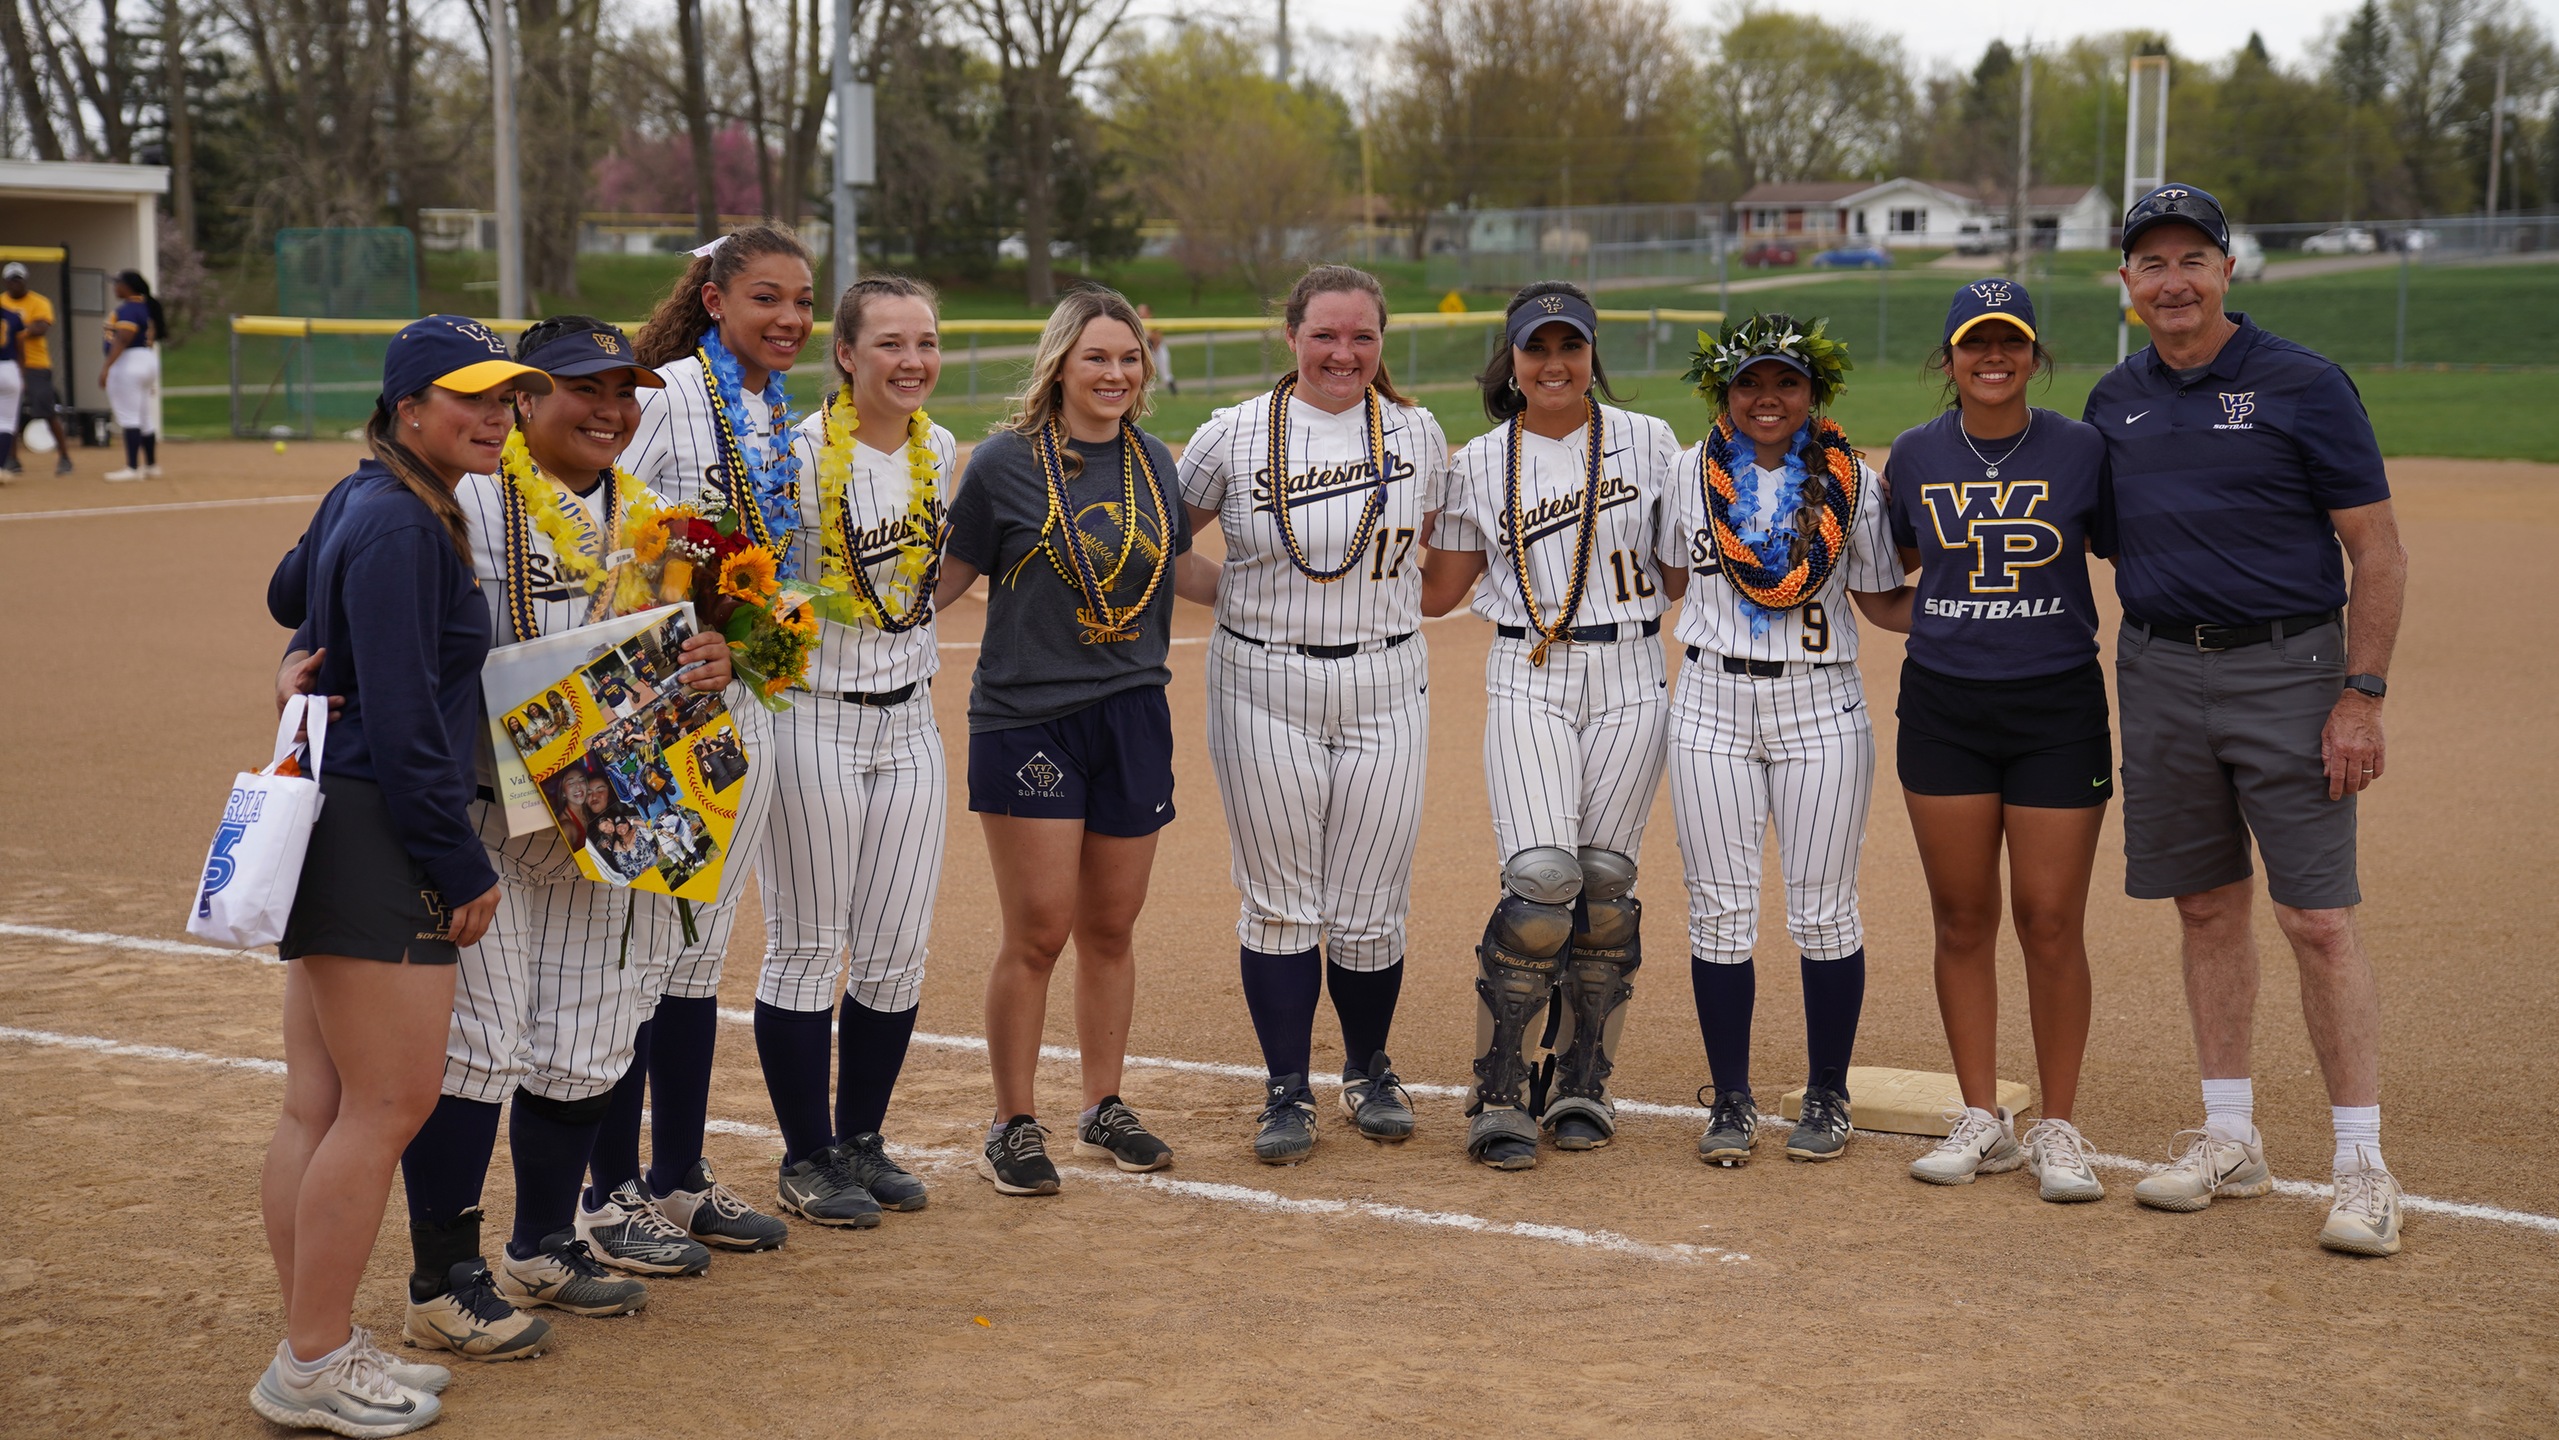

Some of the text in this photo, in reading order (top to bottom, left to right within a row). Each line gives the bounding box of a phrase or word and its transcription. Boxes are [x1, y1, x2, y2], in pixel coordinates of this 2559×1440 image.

[1370, 527, 1415, 582] 17
[1924, 597, 2066, 620] SOFTBALL
[1801, 600, 1830, 655] 9
[510, 774, 526, 786] Val
[1018, 789, 1065, 798] SOFTBALL
[521, 800, 540, 809] Class
[1495, 950, 1553, 969] RAWLINGS
[1571, 948, 1626, 958] AWLINGS
